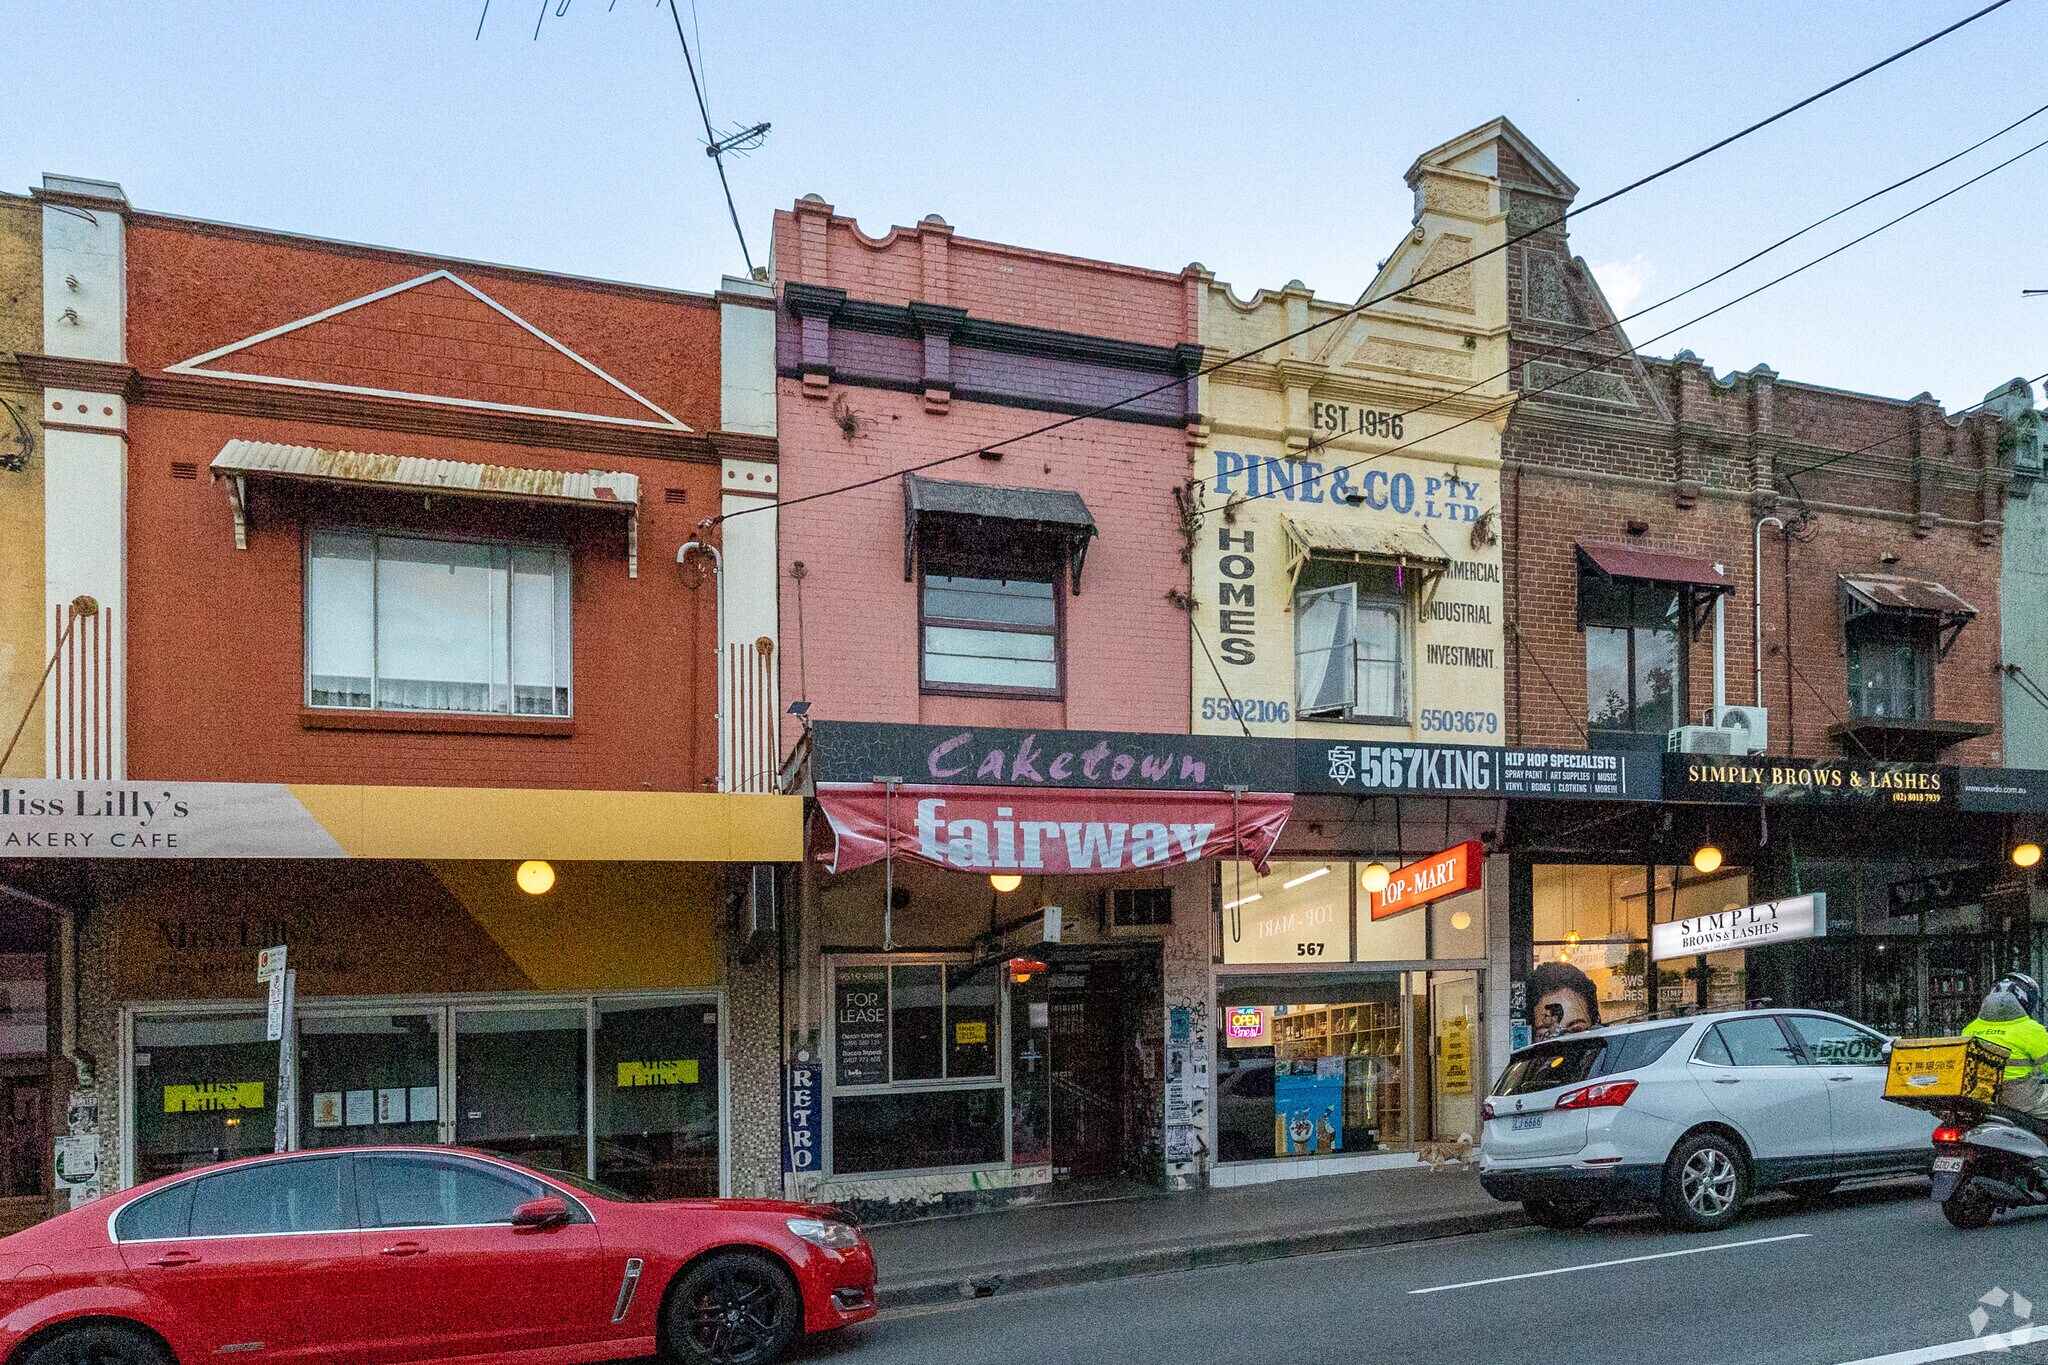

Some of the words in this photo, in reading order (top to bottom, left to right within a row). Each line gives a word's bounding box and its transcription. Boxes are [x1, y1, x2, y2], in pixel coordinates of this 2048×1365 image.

[1313, 402, 1349, 432] EST
[1359, 408, 1404, 440] 1956
[1425, 500, 1480, 523] LTD
[1218, 528, 1255, 666] HOMES
[1201, 695, 1290, 725] 5502106
[1420, 708, 1497, 735] 5503679
[927, 733, 1206, 784] Caketown
[1361, 746, 1490, 789] 567KING
[1505, 752, 1525, 766] HIP
[1527, 753, 1549, 767] HOP
[1550, 754, 1617, 770] SPECIALISTS
[1505, 770, 1525, 779] SPRAY
[1525, 770, 1543, 780] PAINT
[1550, 771, 1561, 780] ART
[1562, 771, 1590, 781] SUPPLIES
[1597, 773, 1617, 781] MUSIC
[1505, 782, 1523, 791] VINYL
[1531, 782, 1551, 792] BOOKS
[1688, 765, 1764, 784] SIMPLY
[1772, 767, 1842, 787] BROWS
[1849, 771, 1862, 787] &
[1870, 771, 1941, 790] LASHES
[0, 788, 65, 816] iss
[74, 790, 189, 826] Lilly's
[5, 832, 94, 847] AKERY
[110, 833, 178, 848] CAFE
[913, 798, 1215, 870] fairway
[1380, 879, 1405, 907] TOP
[1414, 858, 1456, 895] MART
[1681, 902, 1781, 936] SIMPLY
[1682, 931, 1722, 948] BROWS
[1732, 922, 1779, 940] LASHES
[1297, 942, 1325, 956] 567
[846, 992, 878, 1007] FOR
[840, 1008, 884, 1023] LEASE
[1232, 1014, 1260, 1026] OPEN
[1985, 1028, 2006, 1036] Eats
[793, 1070, 813, 1168] RETRO
